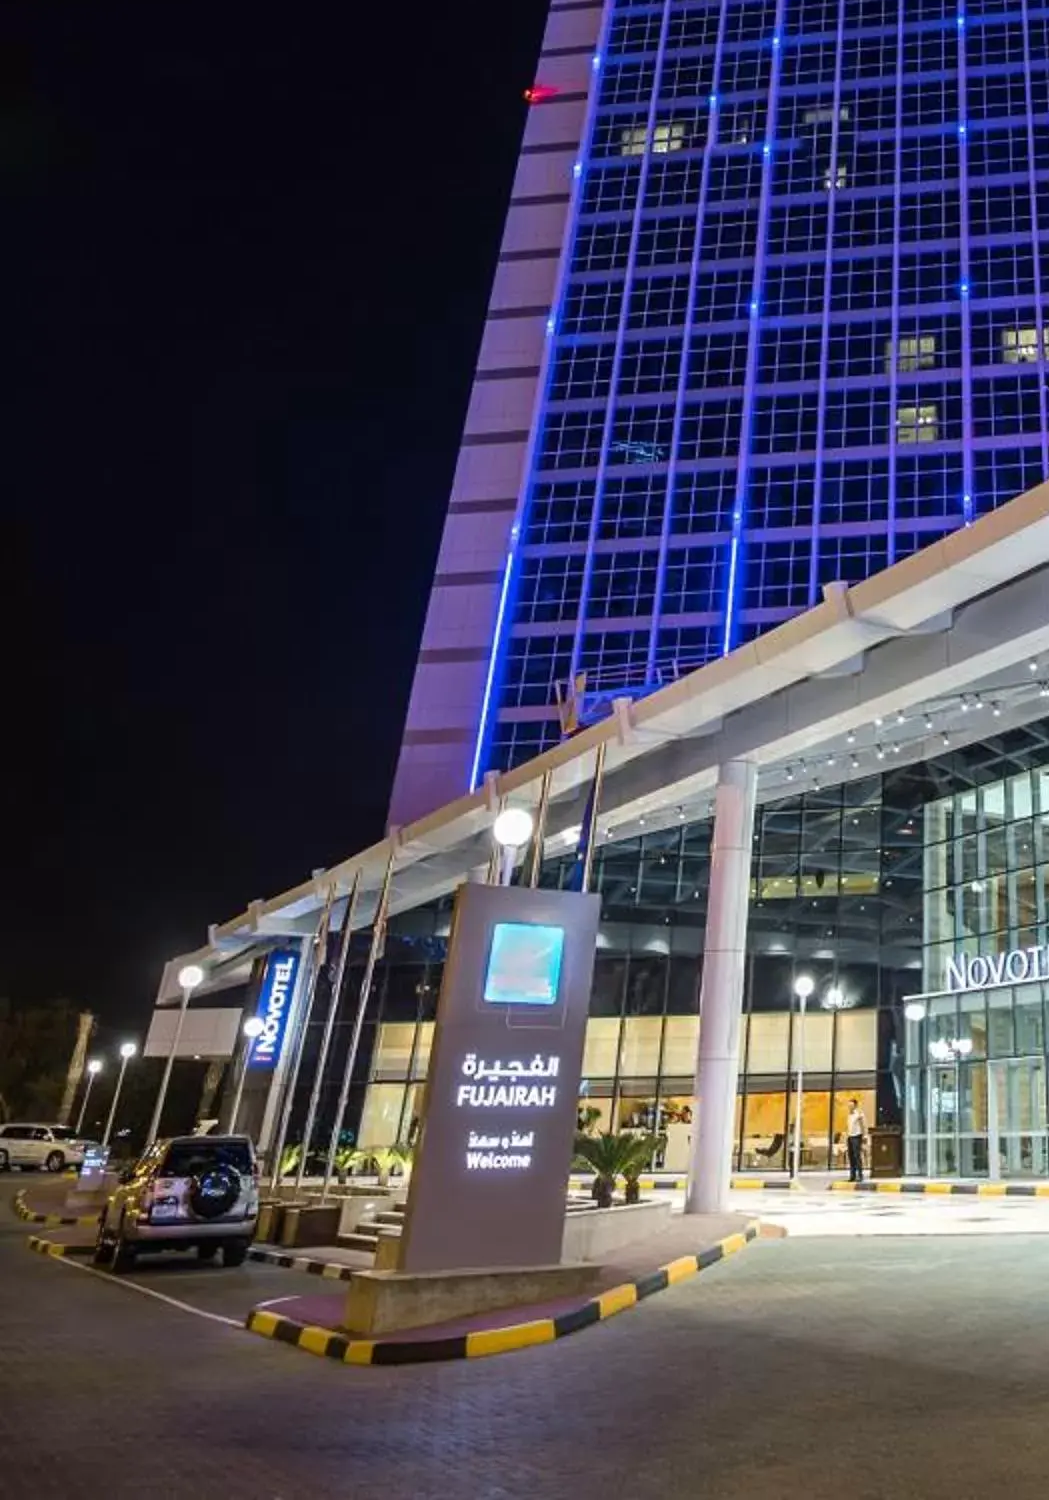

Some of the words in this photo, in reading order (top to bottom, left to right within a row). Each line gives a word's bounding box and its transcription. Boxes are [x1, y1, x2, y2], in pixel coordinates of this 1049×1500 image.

[255, 956, 295, 1054] NOVOTEL
[461, 1053, 560, 1082] الفجيرة
[457, 1085, 557, 1107] FUJAIRAH
[465, 1151, 532, 1170] Welcome
